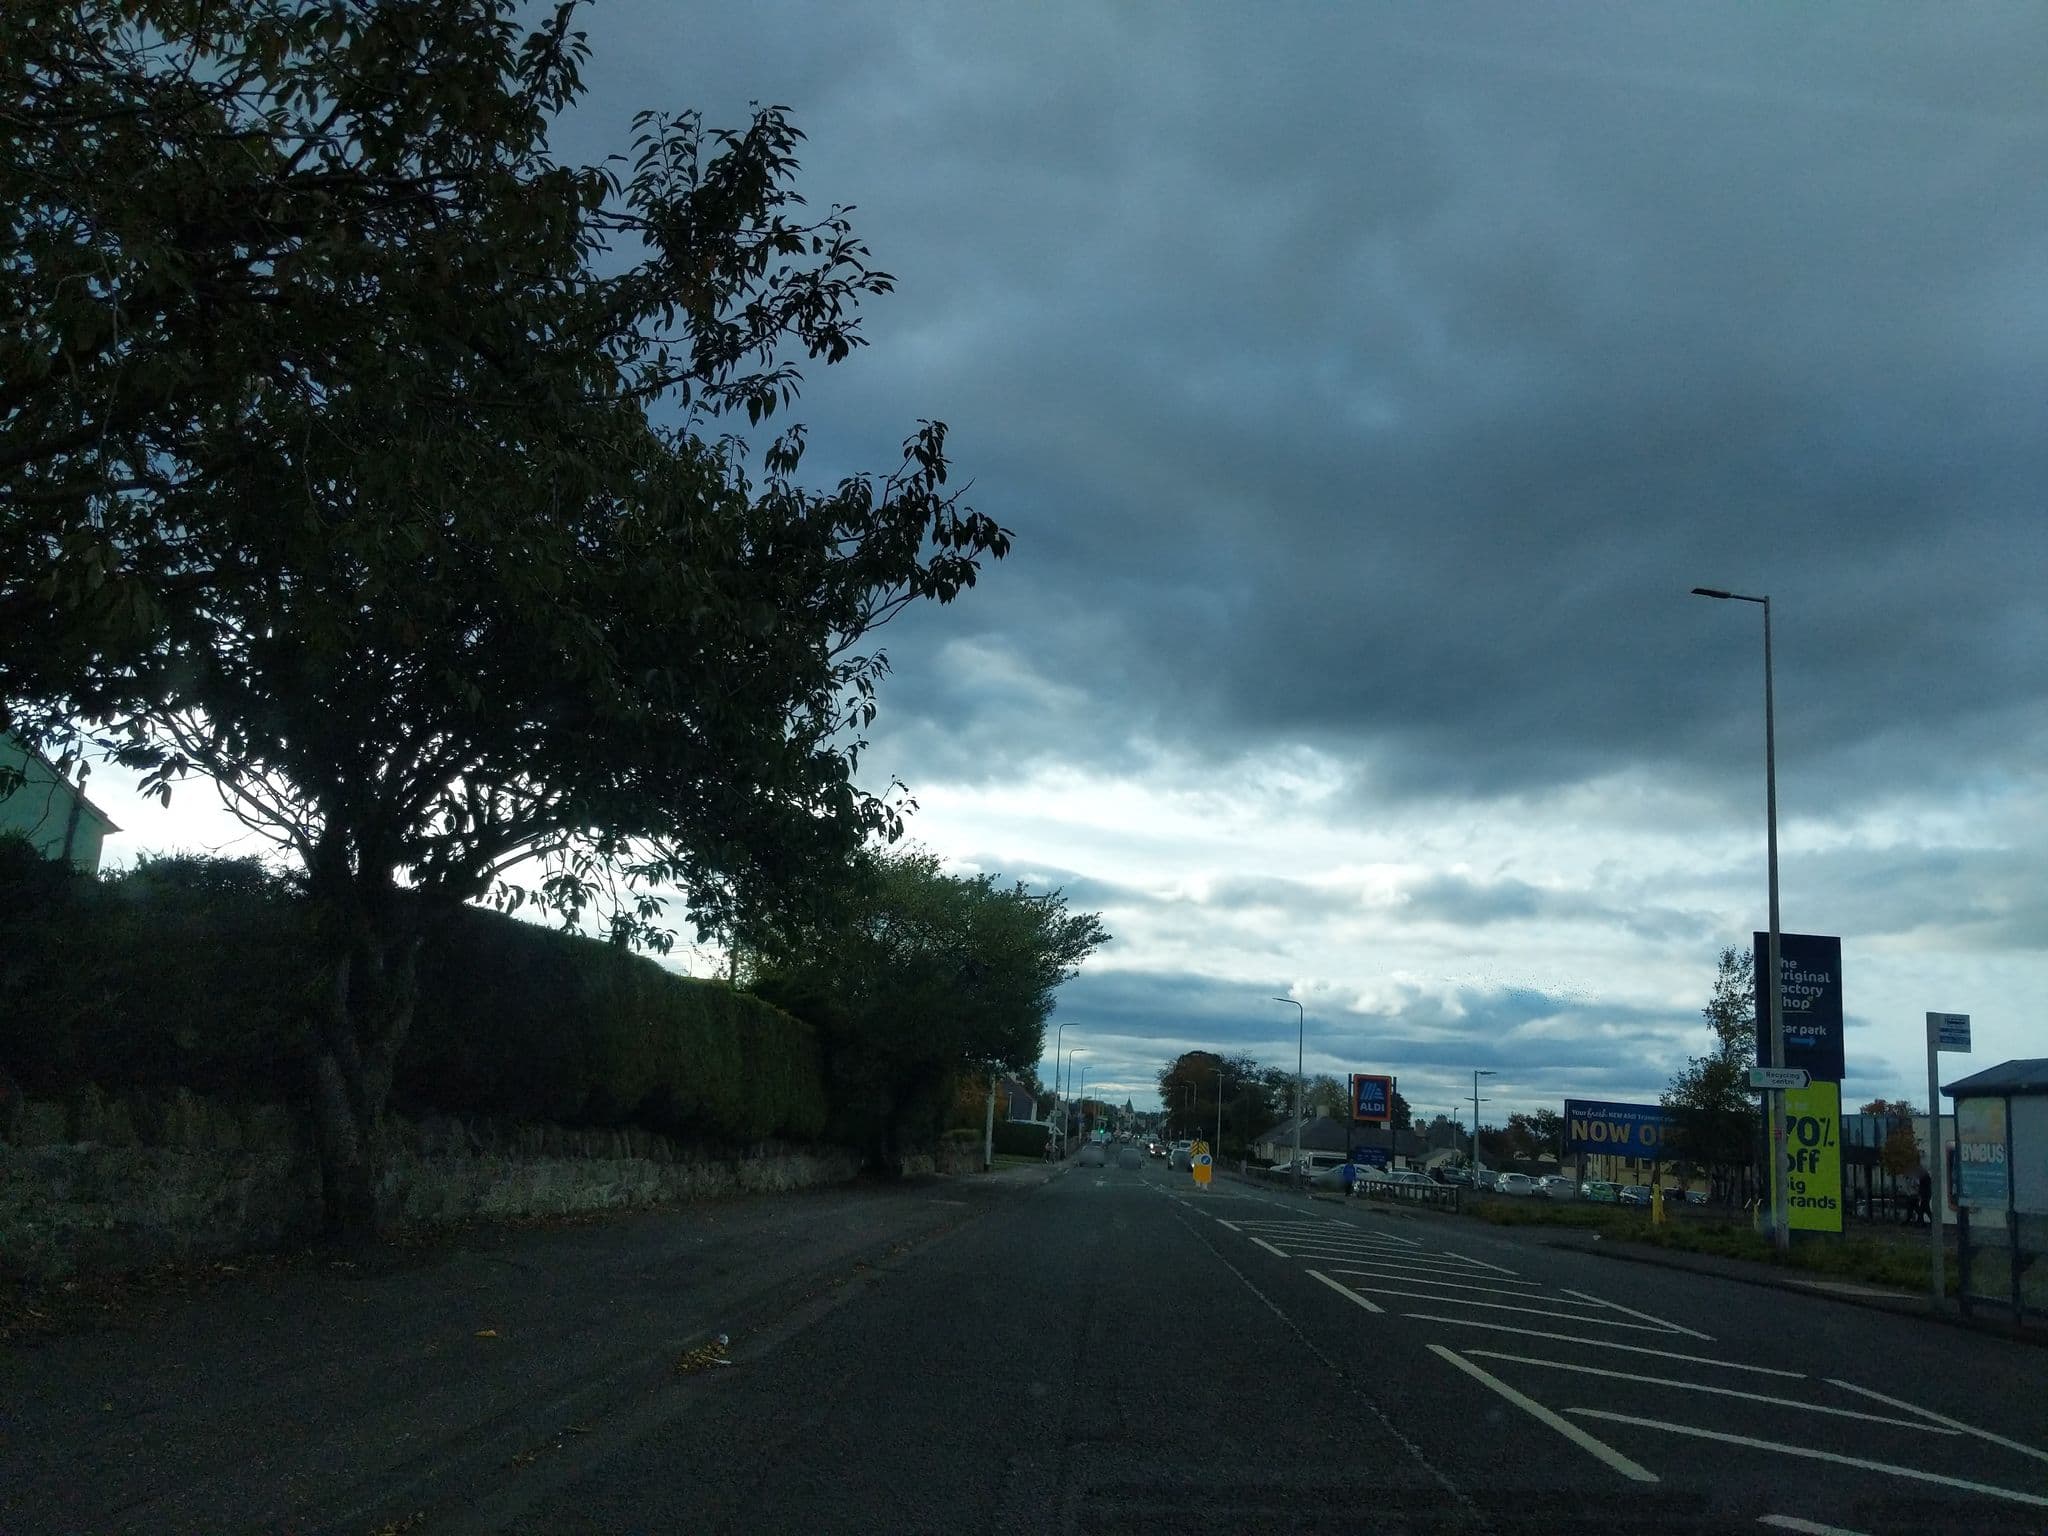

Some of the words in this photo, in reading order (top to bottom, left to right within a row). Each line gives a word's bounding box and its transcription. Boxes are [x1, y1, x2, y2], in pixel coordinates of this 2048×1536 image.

[1780, 957, 1798, 969] he
[1780, 984, 1823, 998] actory
[1782, 996, 1810, 1010] hop
[1800, 1025, 1827, 1036] park
[1360, 1102, 1385, 1112] ALDI
[1571, 1119, 1631, 1144] NOW
[1788, 1177, 1806, 1195] ig
[1788, 1196, 1837, 1210] rands
